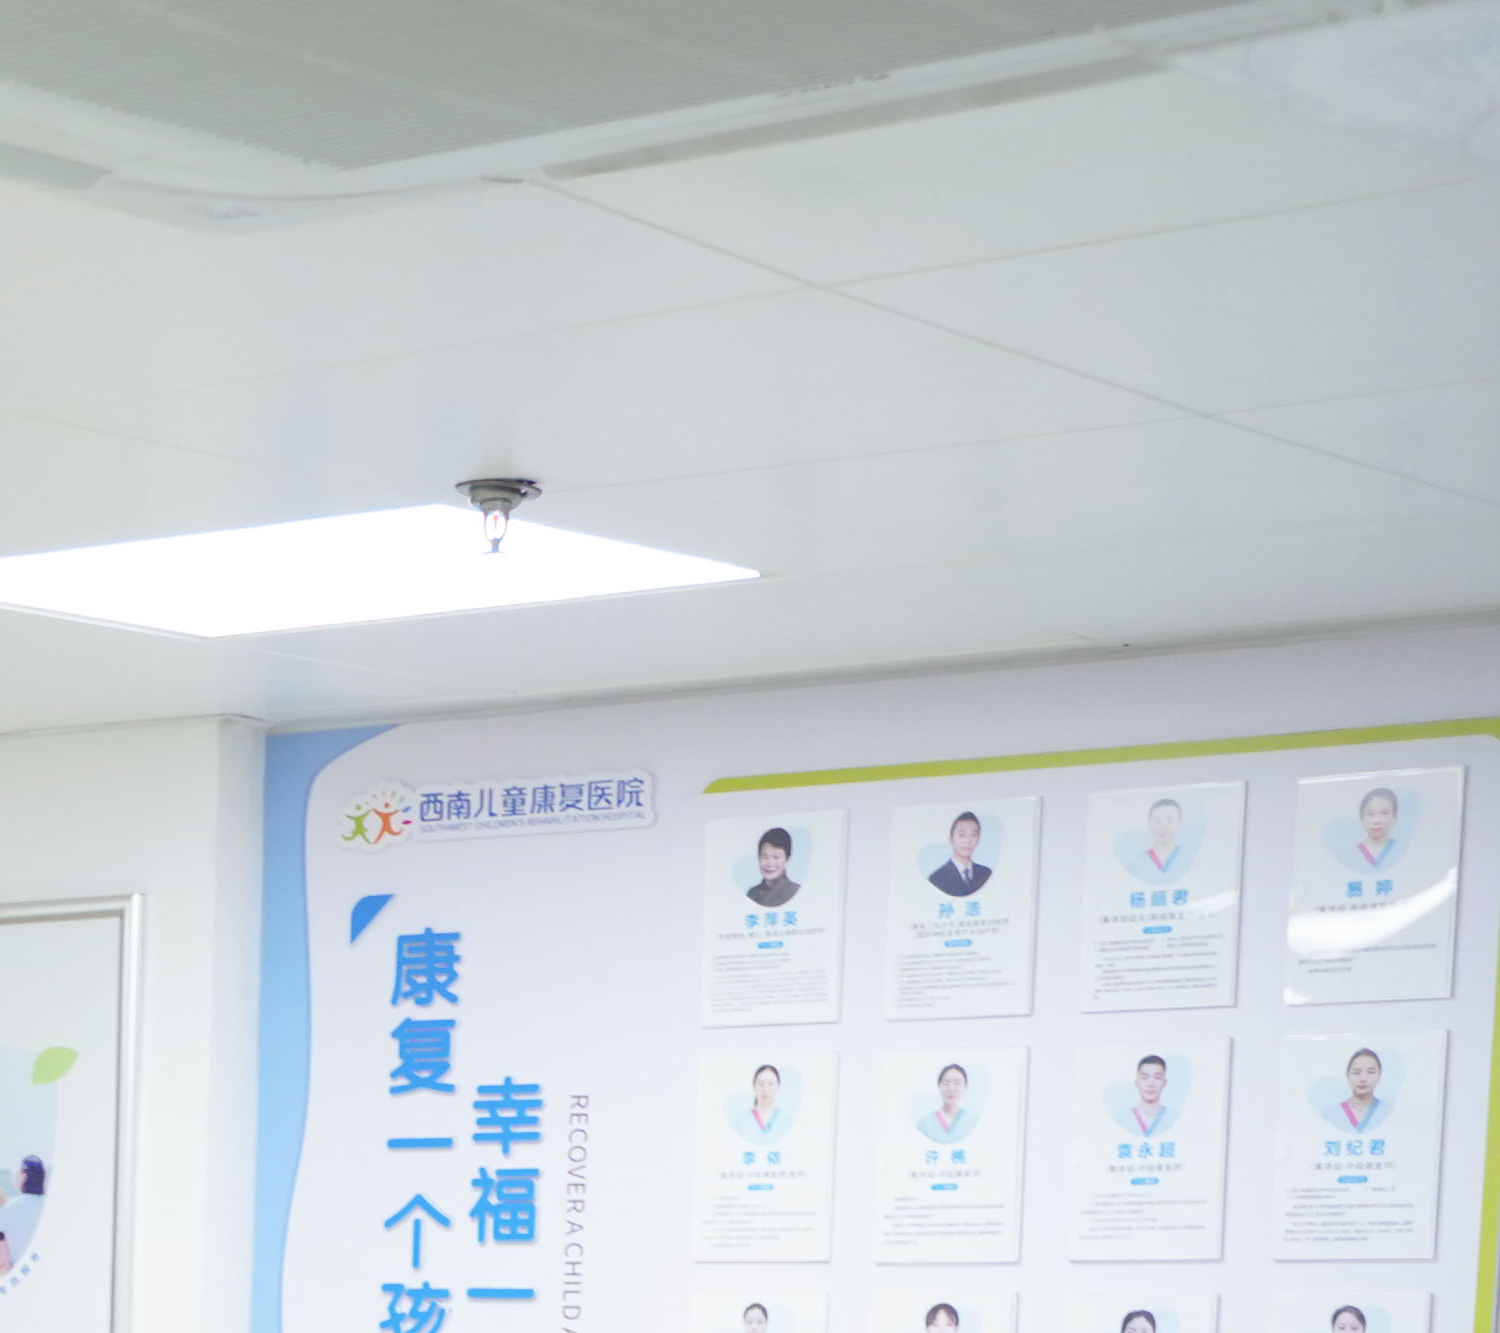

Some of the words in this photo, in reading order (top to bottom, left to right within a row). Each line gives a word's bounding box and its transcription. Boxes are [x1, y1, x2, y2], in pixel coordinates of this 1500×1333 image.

[418, 777, 645, 822] 西南儿童康复医院
[566, 1094, 590, 1214] RECOVER
[565, 1219, 585, 1236] A
[561, 1242, 584, 1321] CHILD
